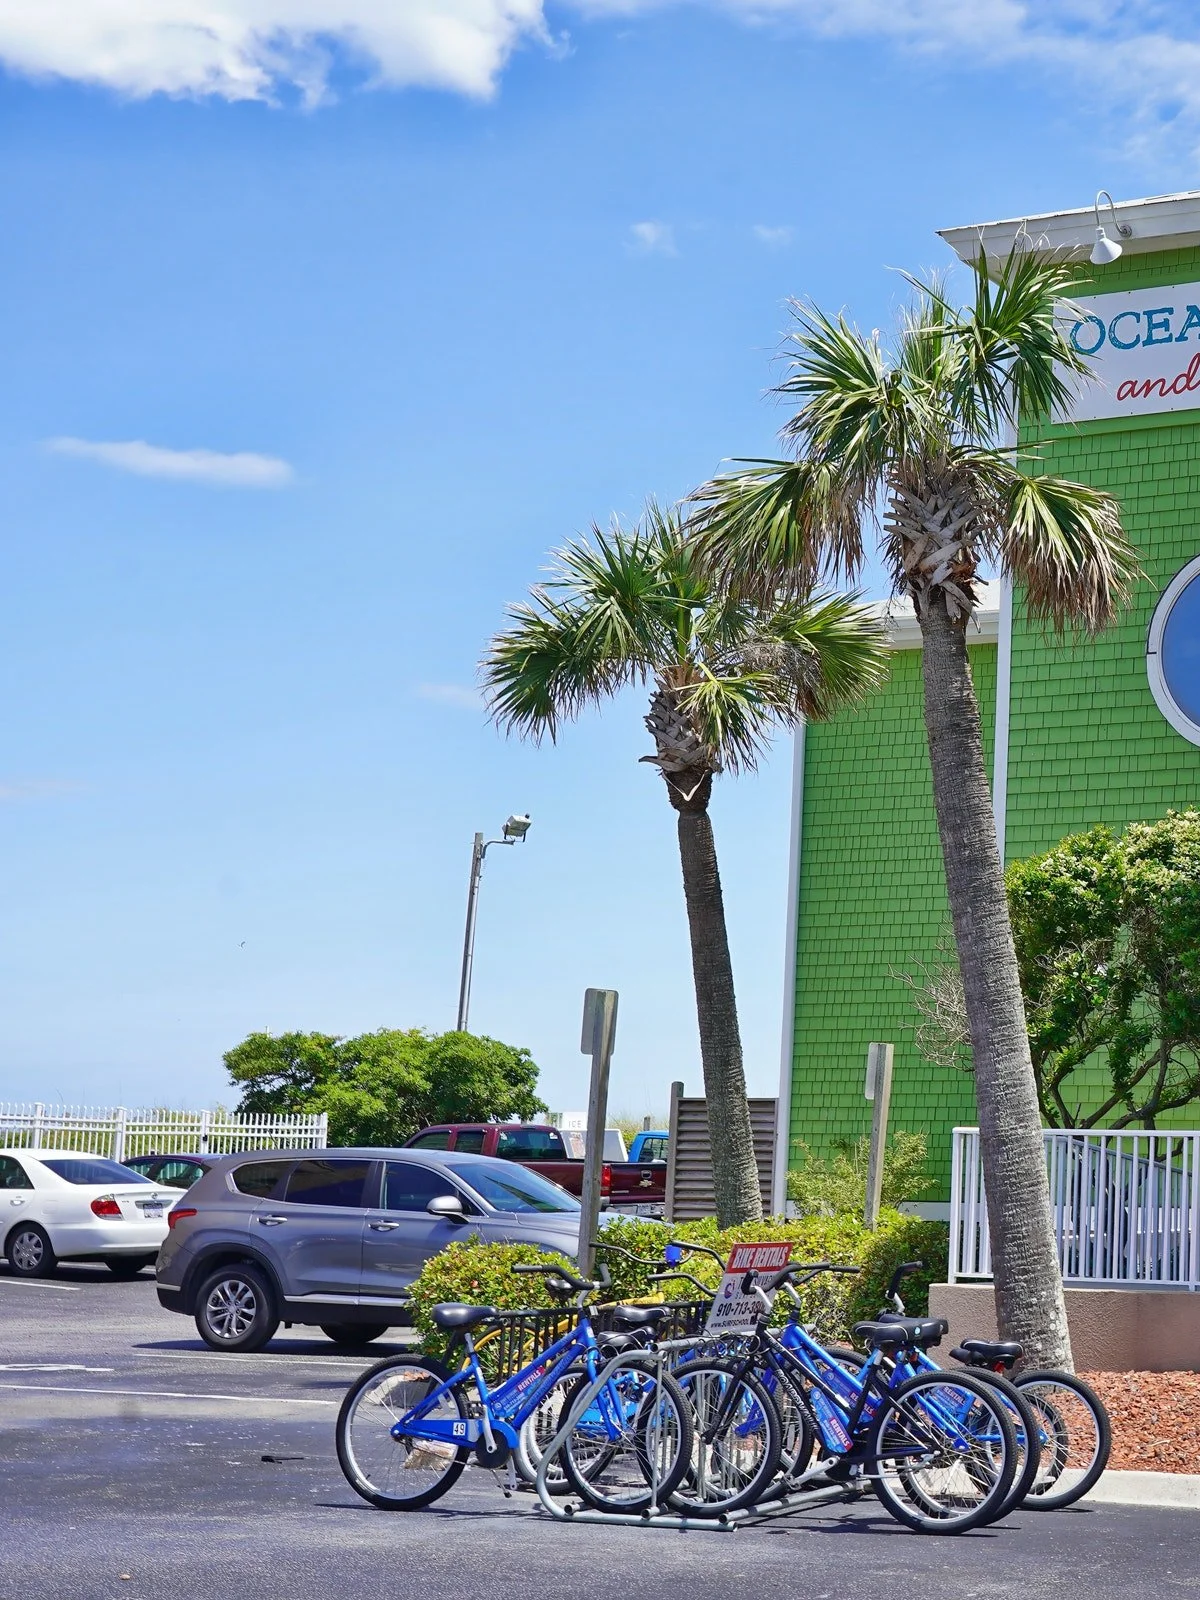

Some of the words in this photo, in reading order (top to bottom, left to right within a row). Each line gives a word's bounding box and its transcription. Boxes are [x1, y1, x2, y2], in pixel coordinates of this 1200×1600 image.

[568, 1120, 582, 1129] ICE
[732, 1247, 757, 1269] BIKE
[751, 1246, 788, 1268] RENTALS
[455, 1424, 465, 1435] 49
[829, 1418, 850, 1446] RENTALS
